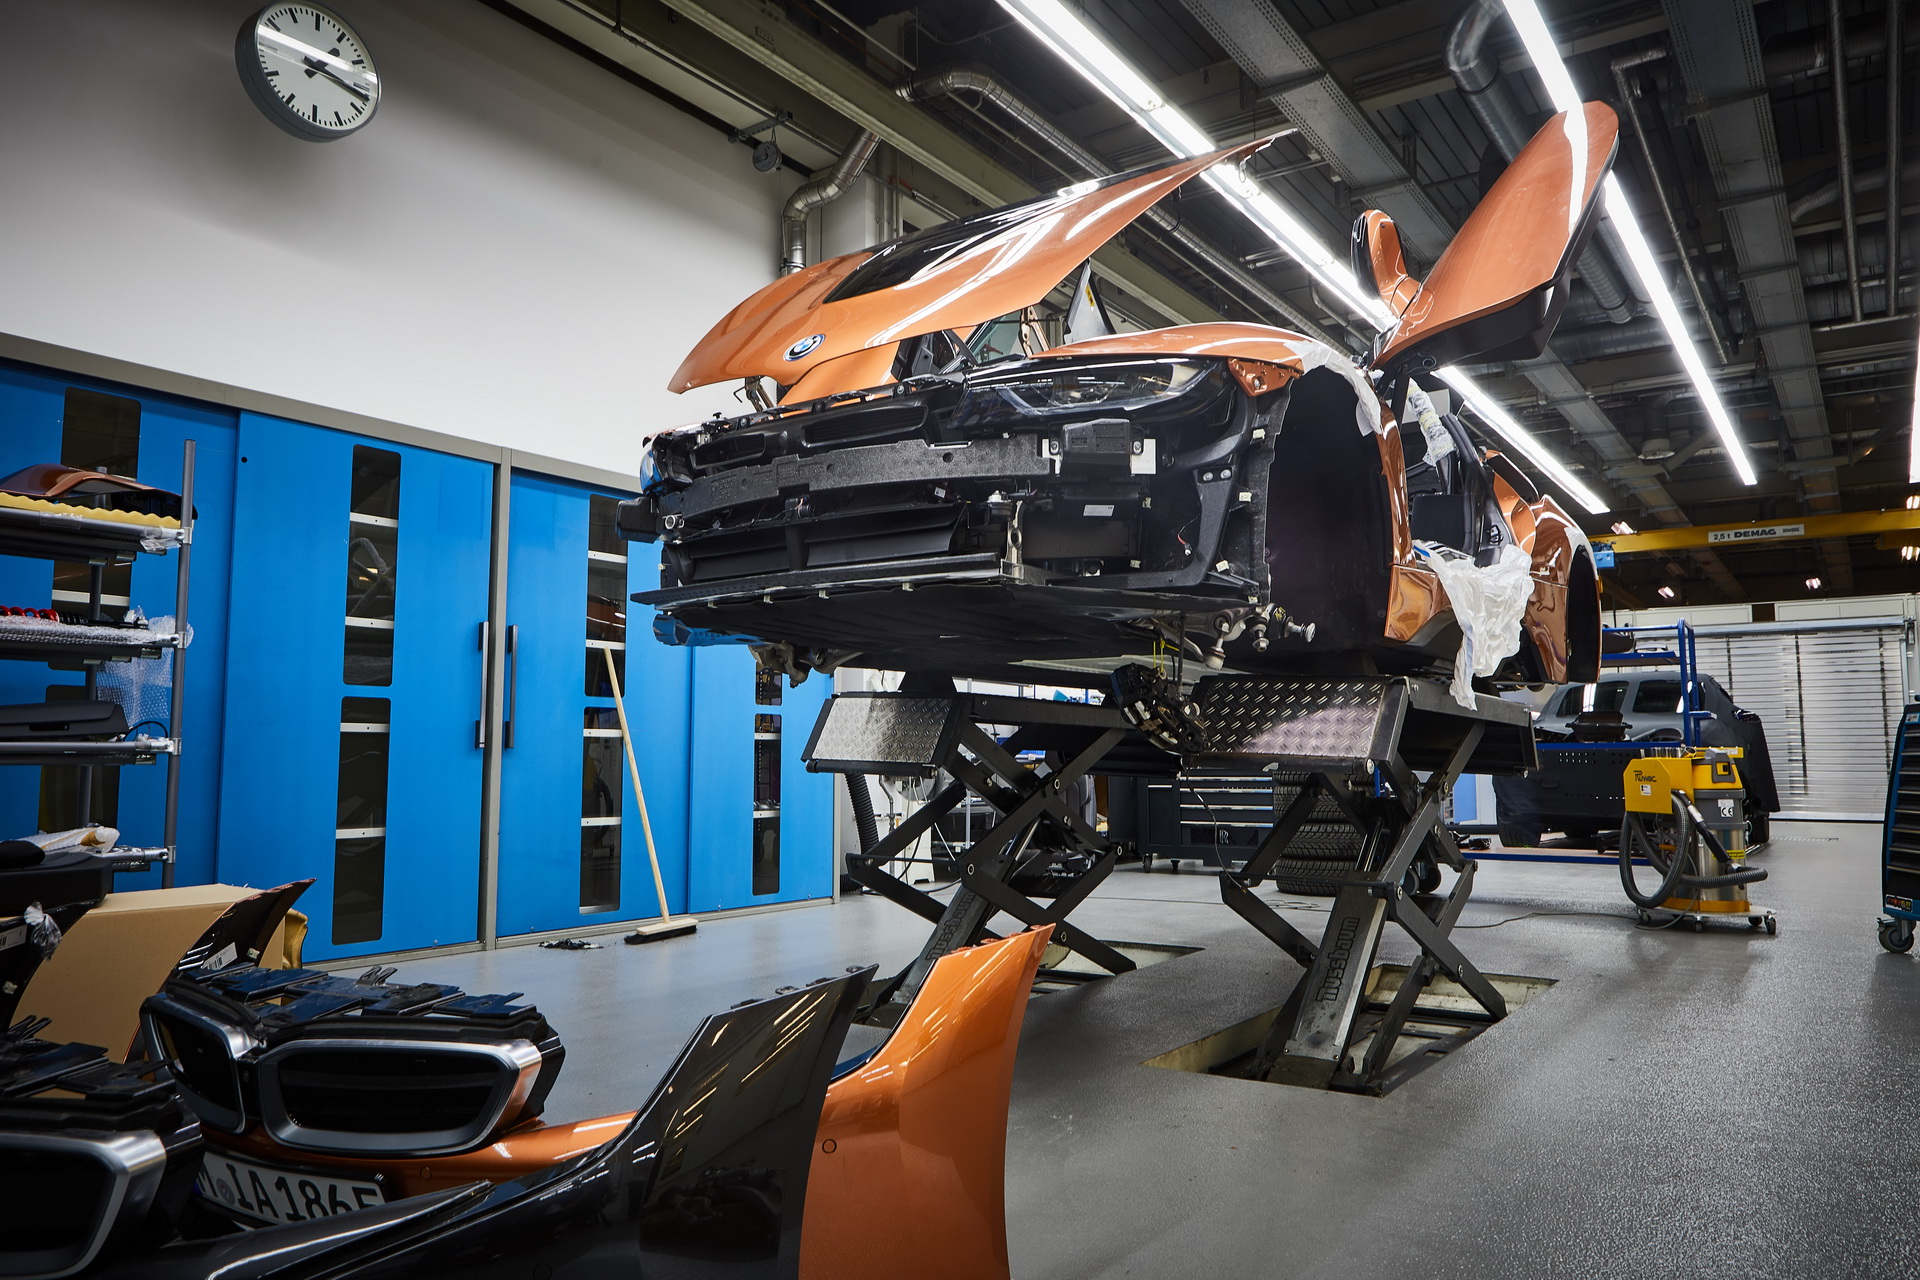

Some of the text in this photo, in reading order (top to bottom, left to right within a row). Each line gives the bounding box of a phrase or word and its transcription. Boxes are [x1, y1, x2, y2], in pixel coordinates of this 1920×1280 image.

[1713, 533, 1725, 541] 2,5
[1733, 528, 1777, 539] DEMAG
[1721, 807, 1733, 817] CE
[1315, 916, 1361, 1002] Nussbaum
